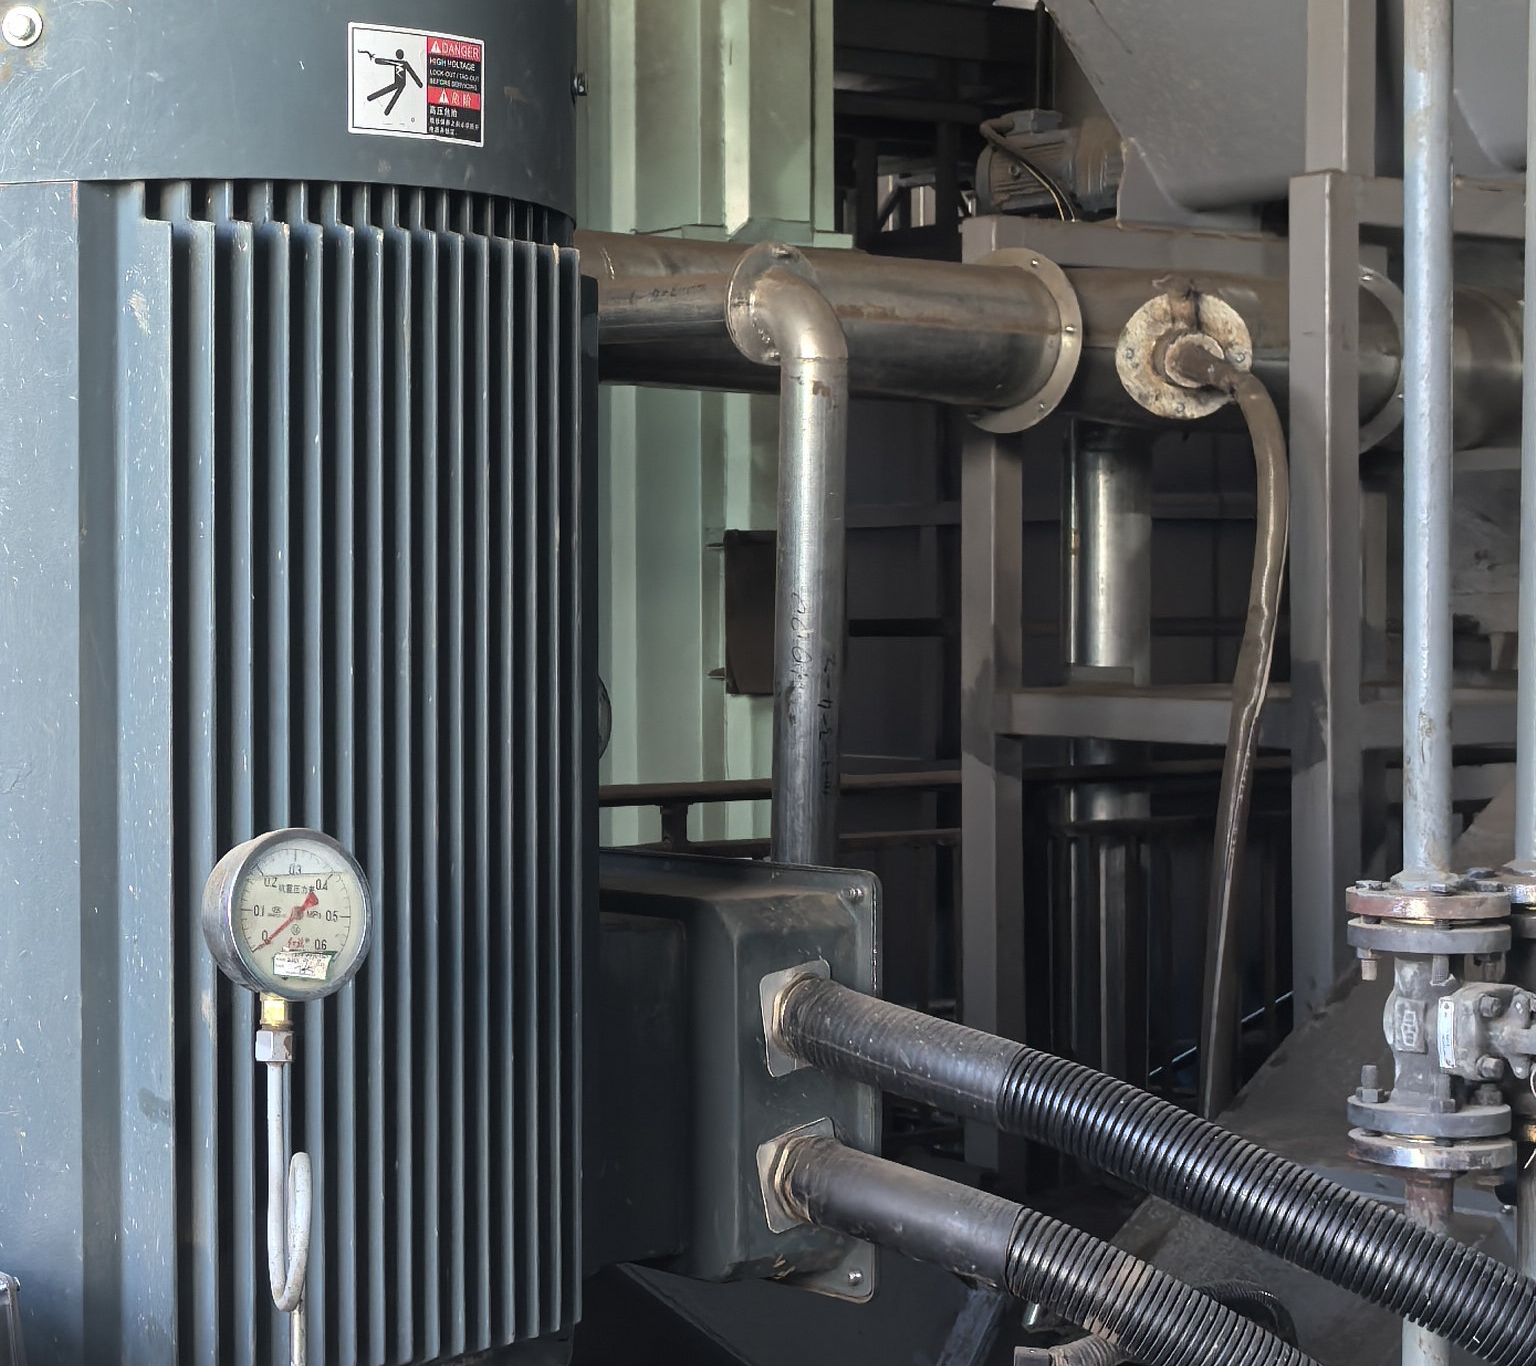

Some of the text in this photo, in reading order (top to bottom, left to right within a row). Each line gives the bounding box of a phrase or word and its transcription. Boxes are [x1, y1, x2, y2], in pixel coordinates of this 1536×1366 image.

[442, 42, 479, 58] DANGER
[430, 57, 475, 71] HIGH VOLTAGE
[430, 78, 450, 86] BEFORE
[430, 105, 457, 117] 高压危险
[289, 864, 302, 875] 0.3
[263, 878, 277, 888] 0.2
[315, 878, 328, 891] 0.4
[254, 905, 265, 917] 0.1
[325, 910, 338, 922] 0.5
[315, 939, 327, 950] 0.6
